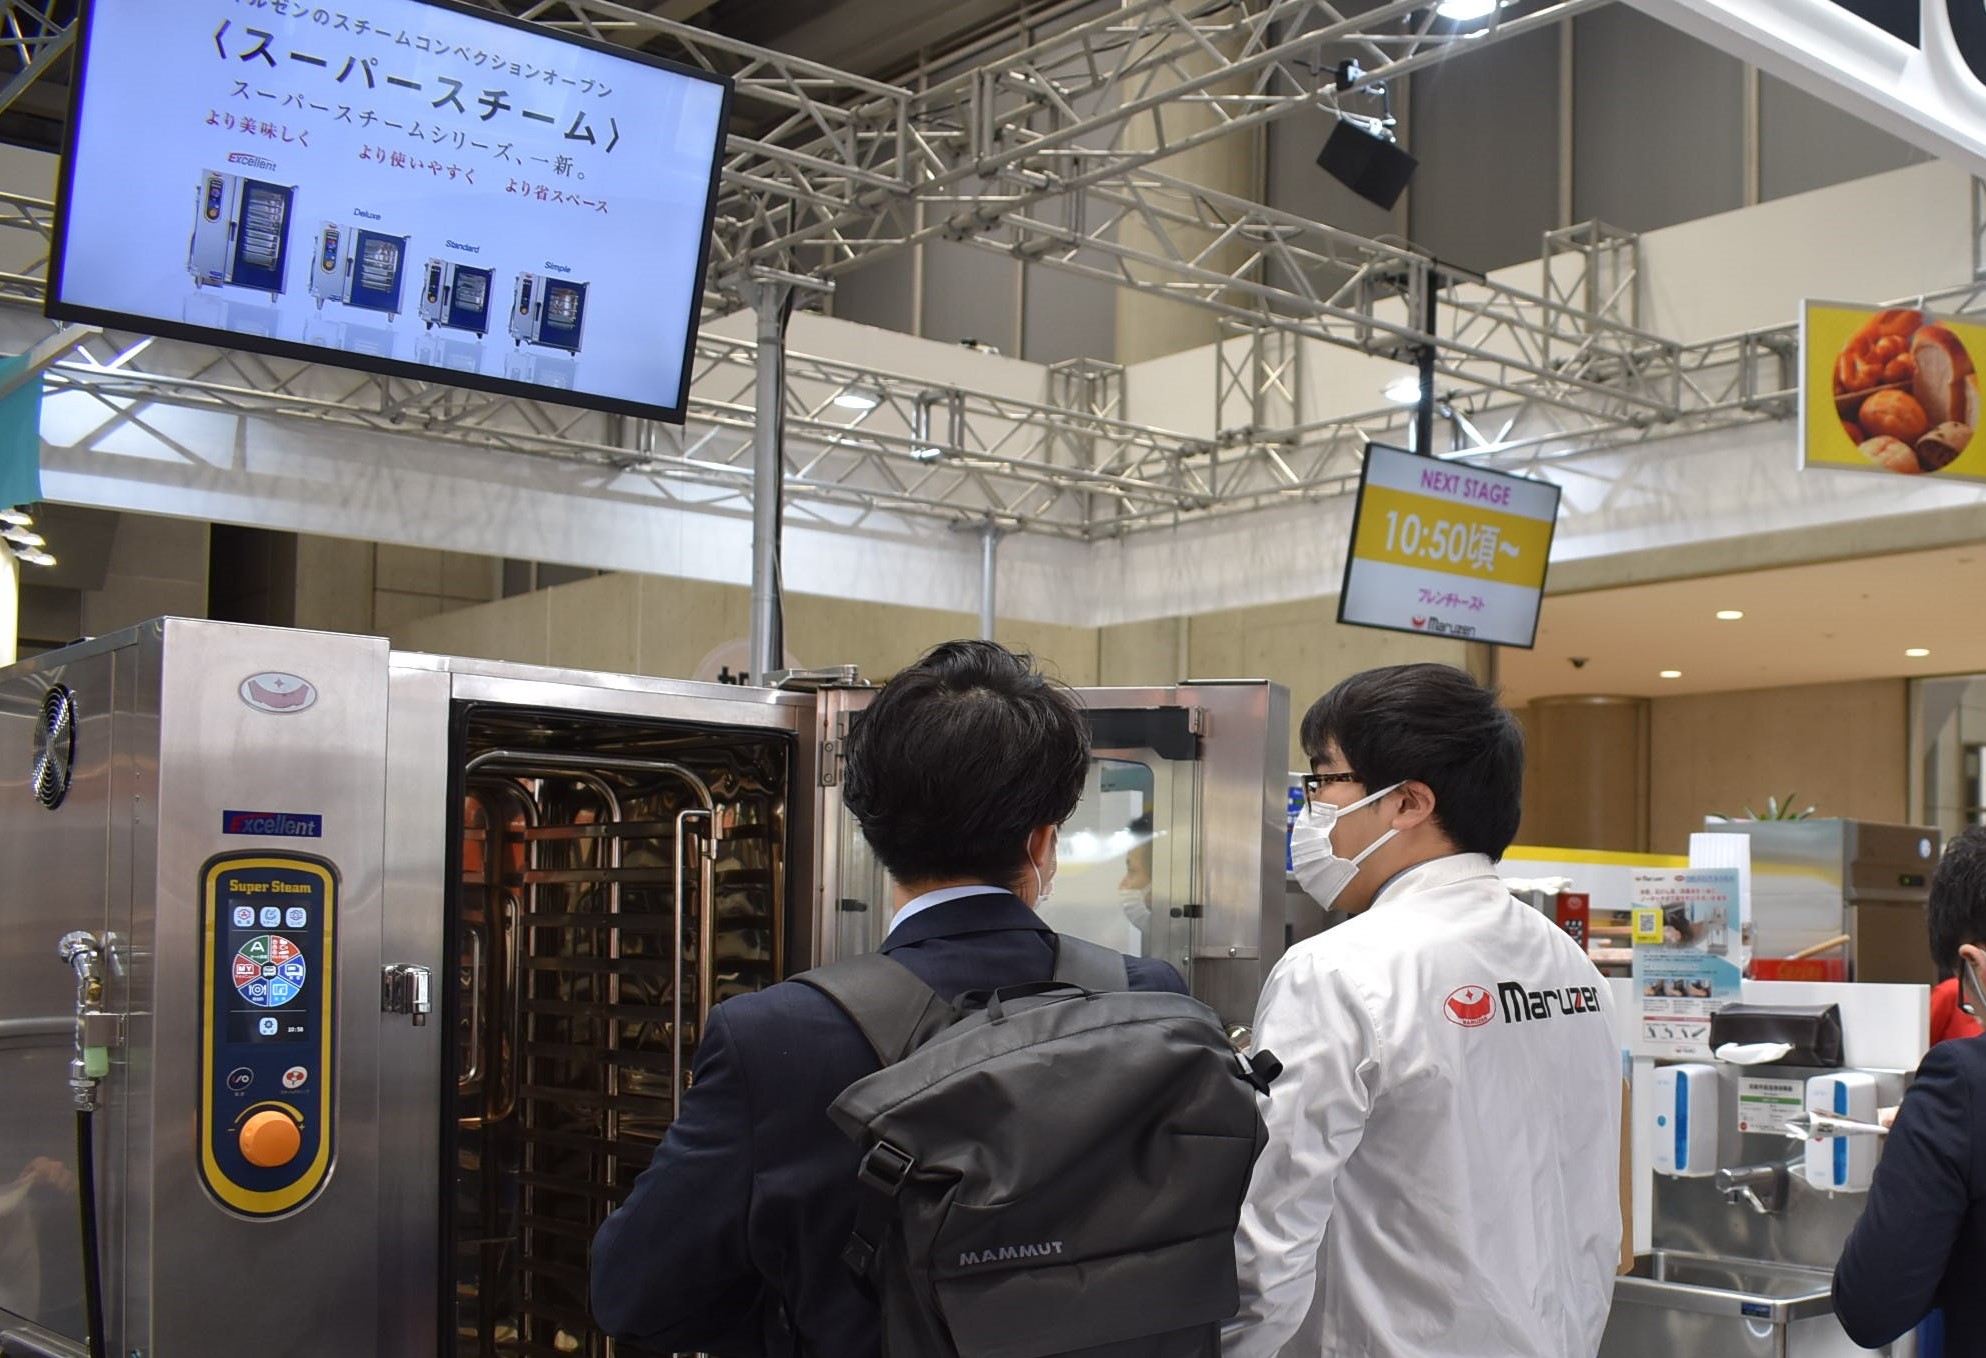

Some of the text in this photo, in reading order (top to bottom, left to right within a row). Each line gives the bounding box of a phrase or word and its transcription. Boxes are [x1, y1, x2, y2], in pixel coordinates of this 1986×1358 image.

[235, 0, 612, 98] ルゼンのスチームコンベクションオーブン
[230, 80, 585, 180] スーパースチームシリーズ、一新。
[205, 109, 609, 214] より美味しく より使いやすく より省スペース
[228, 152, 277, 172] Excellent
[353, 207, 382, 221] Deluxe
[445, 239, 480, 253] Standard
[544, 260, 572, 274] Simple
[1420, 468, 1512, 506] NEXT STAGE
[1427, 615, 1477, 637] Maruzen
[230, 812, 316, 836] Excellent
[229, 879, 312, 895] Super Steam
[958, 1241, 1064, 1266] MAMMUT
